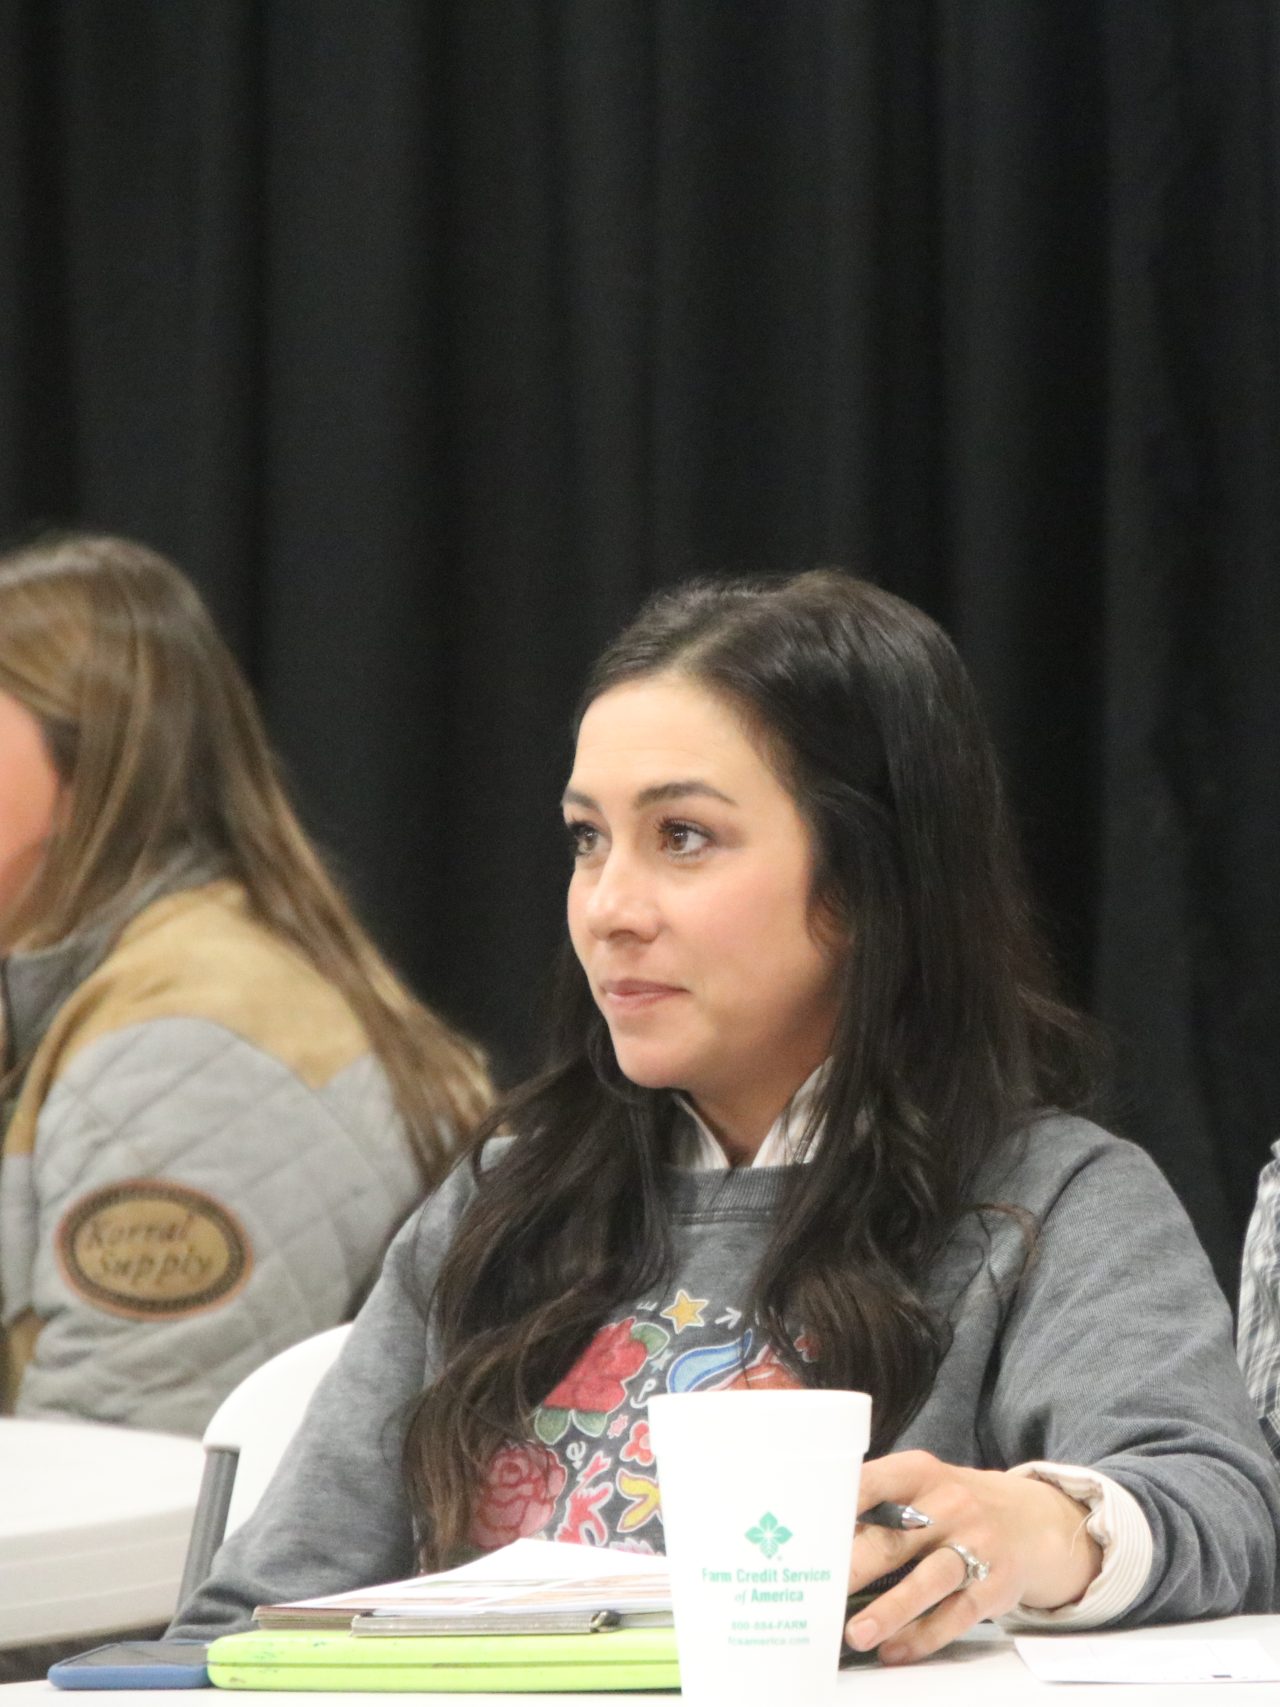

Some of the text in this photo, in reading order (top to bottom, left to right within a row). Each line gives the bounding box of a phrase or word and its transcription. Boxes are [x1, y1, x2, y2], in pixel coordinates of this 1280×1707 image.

[99, 1242, 213, 1286] Supply
[701, 1567, 831, 1583] Farm Credit Services
[734, 1588, 804, 1605] of America
